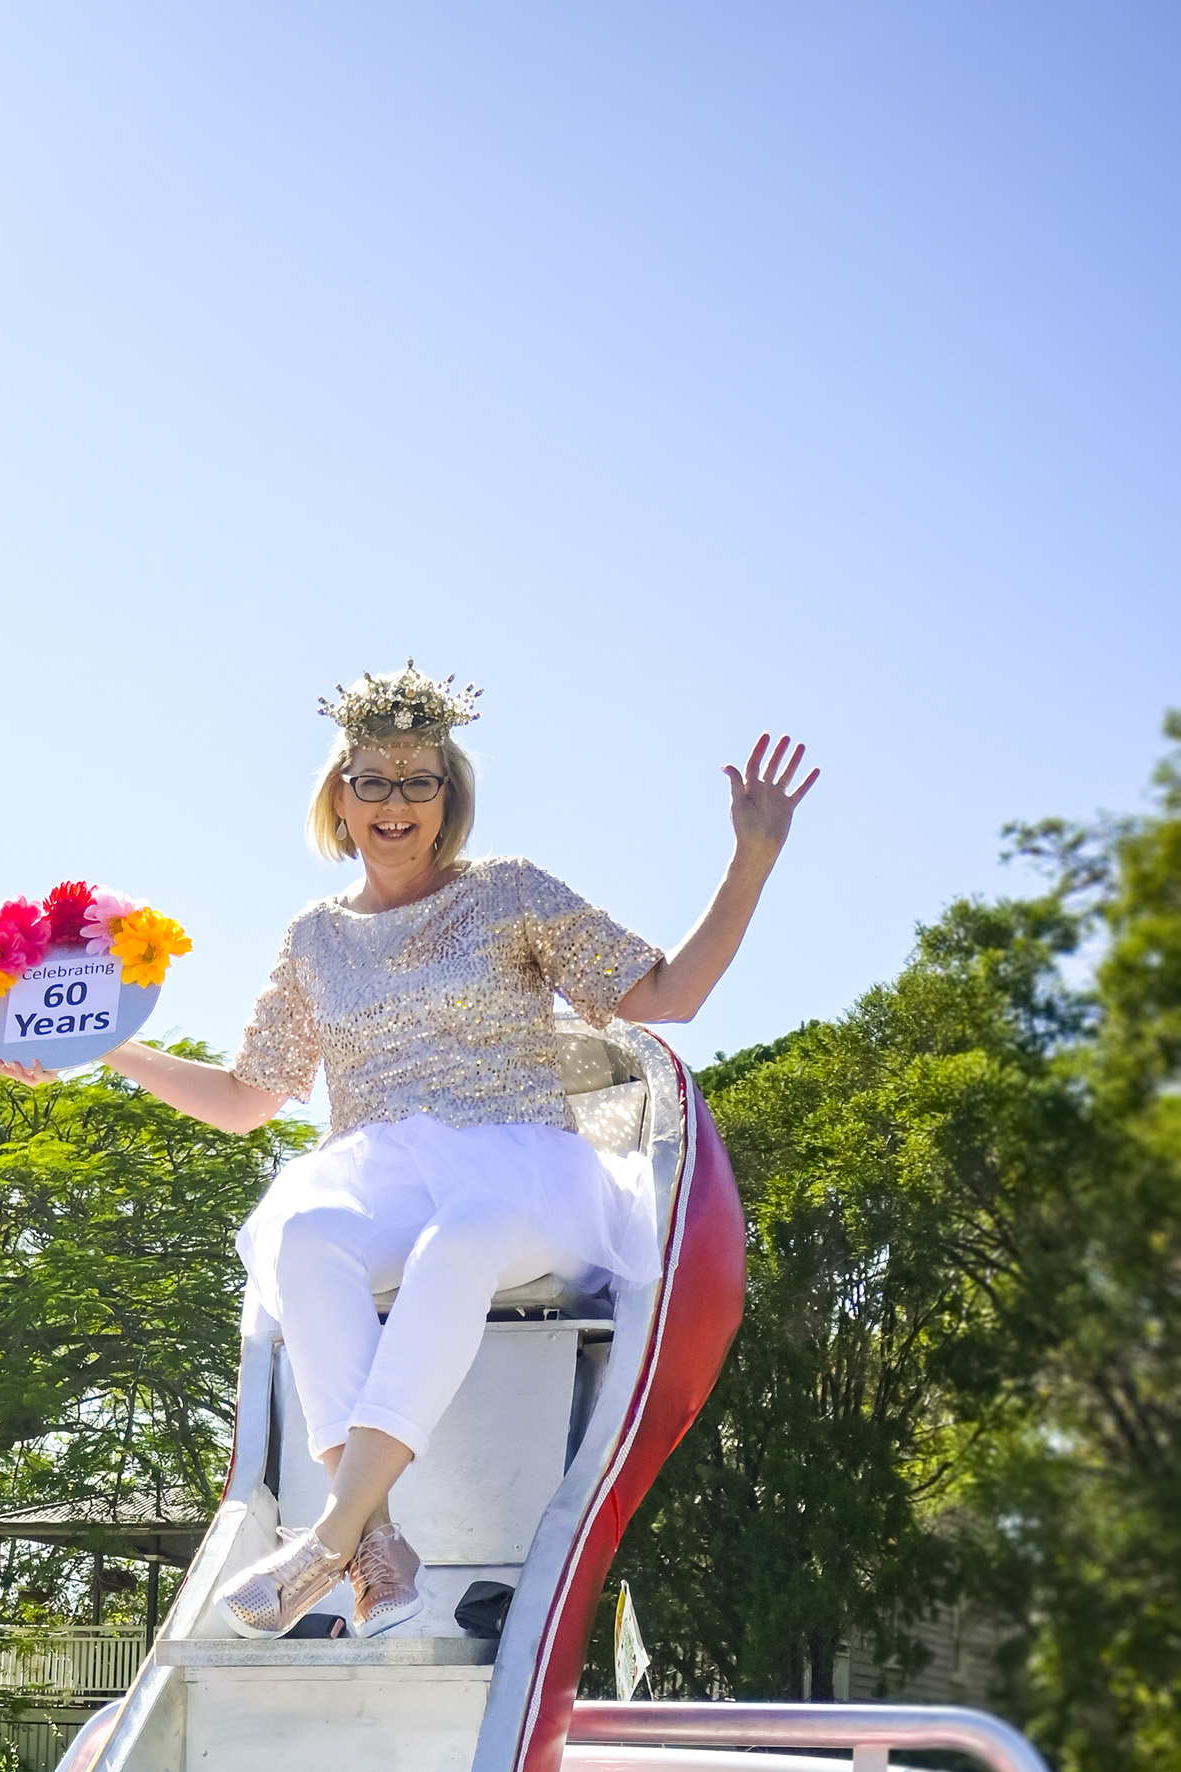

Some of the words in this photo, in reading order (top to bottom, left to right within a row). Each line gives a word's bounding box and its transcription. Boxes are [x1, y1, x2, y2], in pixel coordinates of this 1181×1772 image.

[23, 962, 115, 980] Celebrating
[44, 981, 88, 1008] 60
[15, 1011, 110, 1037] Years
